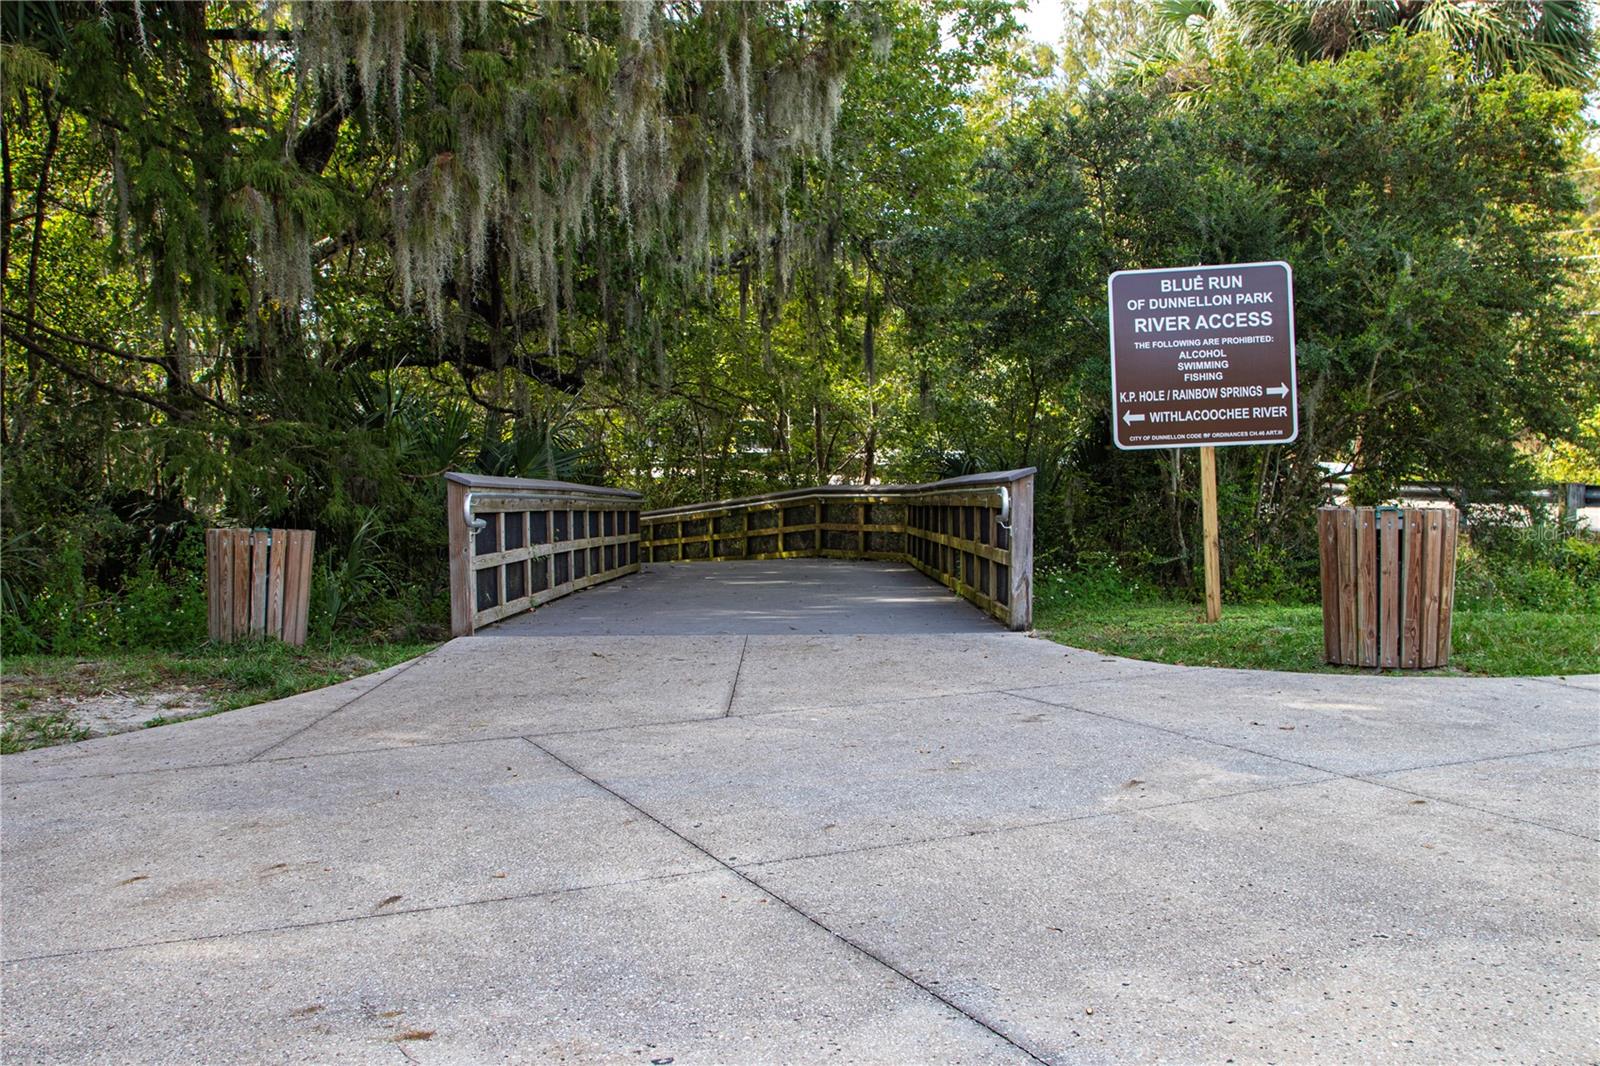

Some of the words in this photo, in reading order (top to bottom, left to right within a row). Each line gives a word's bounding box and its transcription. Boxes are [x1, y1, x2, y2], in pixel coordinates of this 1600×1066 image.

[1161, 277, 1203, 292] BLUE
[1209, 275, 1243, 290] RUN
[1127, 299, 1145, 311] OF
[1149, 295, 1232, 310] DUNNELLON
[1236, 292, 1273, 305] PARK
[1134, 316, 1191, 333] RIVER
[1195, 311, 1273, 330] ACCESS
[1134, 342, 1150, 350] THE
[1152, 339, 1201, 348] FOLLOWING
[1202, 338, 1220, 346] ARE
[1221, 335, 1274, 345] PROHIBITED:
[1179, 349, 1227, 360] ALCOHOL
[1177, 360, 1229, 371] SWIMMING
[1184, 372, 1223, 382] FISHING
[1120, 392, 1137, 403] K.P.
[1139, 390, 1165, 402] HOLE
[1172, 387, 1218, 400] RAINBOW
[1220, 385, 1263, 398] SPRINGS
[1149, 408, 1250, 422] WITHLACOOCHEE
[1253, 406, 1288, 418] RIVER
[1151, 433, 1186, 441] DUNNELLON
[1212, 430, 1249, 438] ORDINANCES
